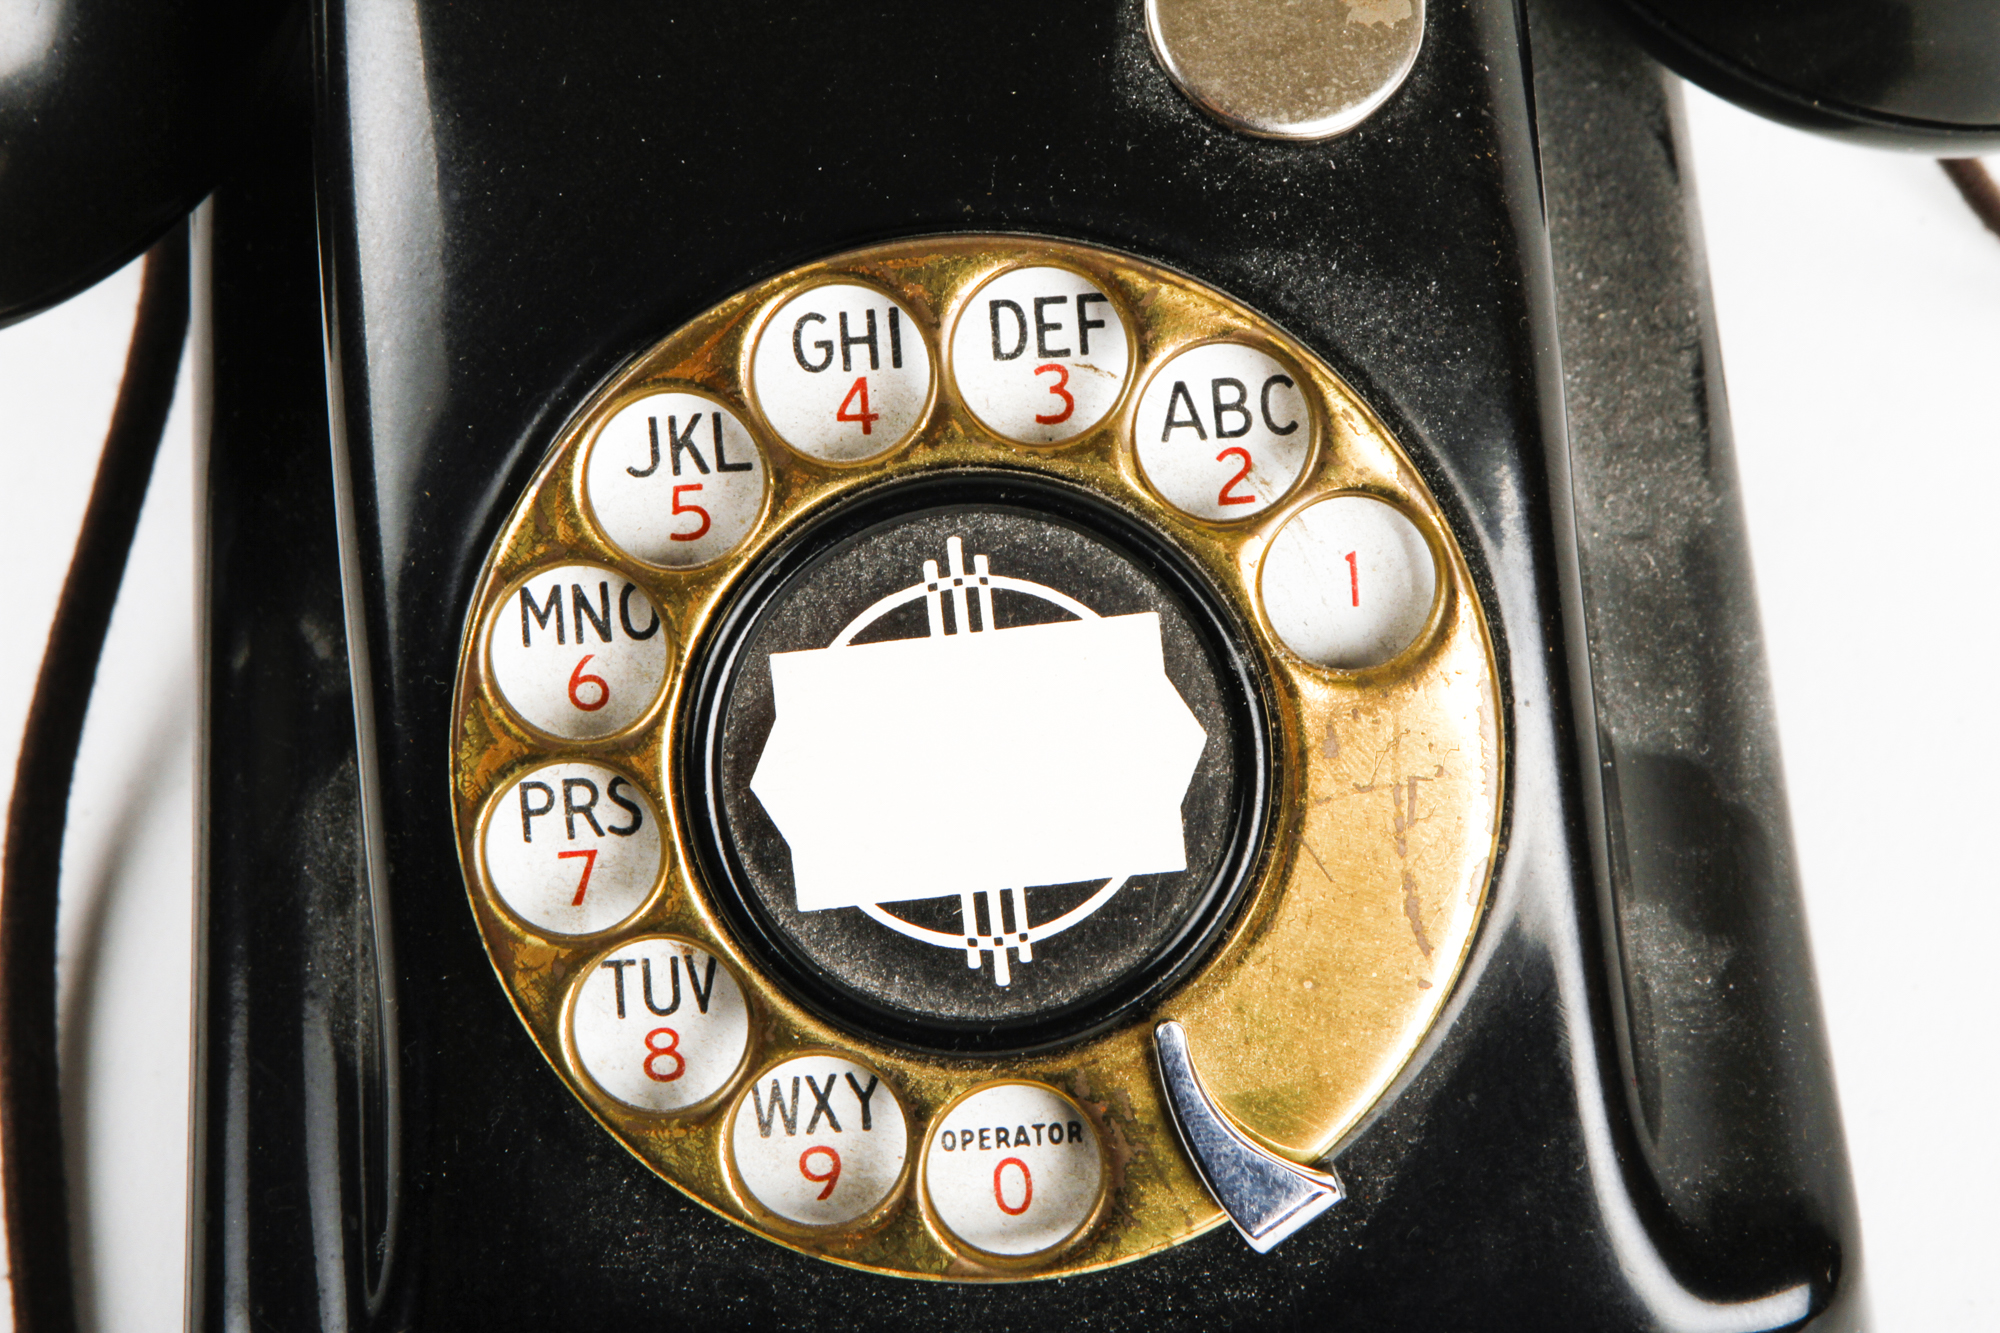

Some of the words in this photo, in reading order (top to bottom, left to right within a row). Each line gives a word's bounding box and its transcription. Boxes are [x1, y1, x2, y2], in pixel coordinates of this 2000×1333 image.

[792, 306, 903, 373] GHI
[988, 292, 1108, 362] DEF
[836, 376, 879, 435] 4
[1033, 363, 1075, 425] 3
[1160, 374, 1299, 443] ABC
[626, 411, 753, 478] JKL
[1215, 446, 1256, 507] 2
[669, 484, 711, 542] 5
[1344, 551, 1360, 608] 1
[519, 581, 660, 647] MNO
[567, 654, 610, 712] 6
[519, 775, 643, 843] PRS
[557, 849, 598, 907] 7
[600, 954, 717, 1020] TUV
[643, 1026, 686, 1083] 8
[751, 1071, 879, 1138] WXY
[940, 1120, 1084, 1152] OPERATOR
[799, 1145, 842, 1201] 9
[992, 1156, 1034, 1216] 0
